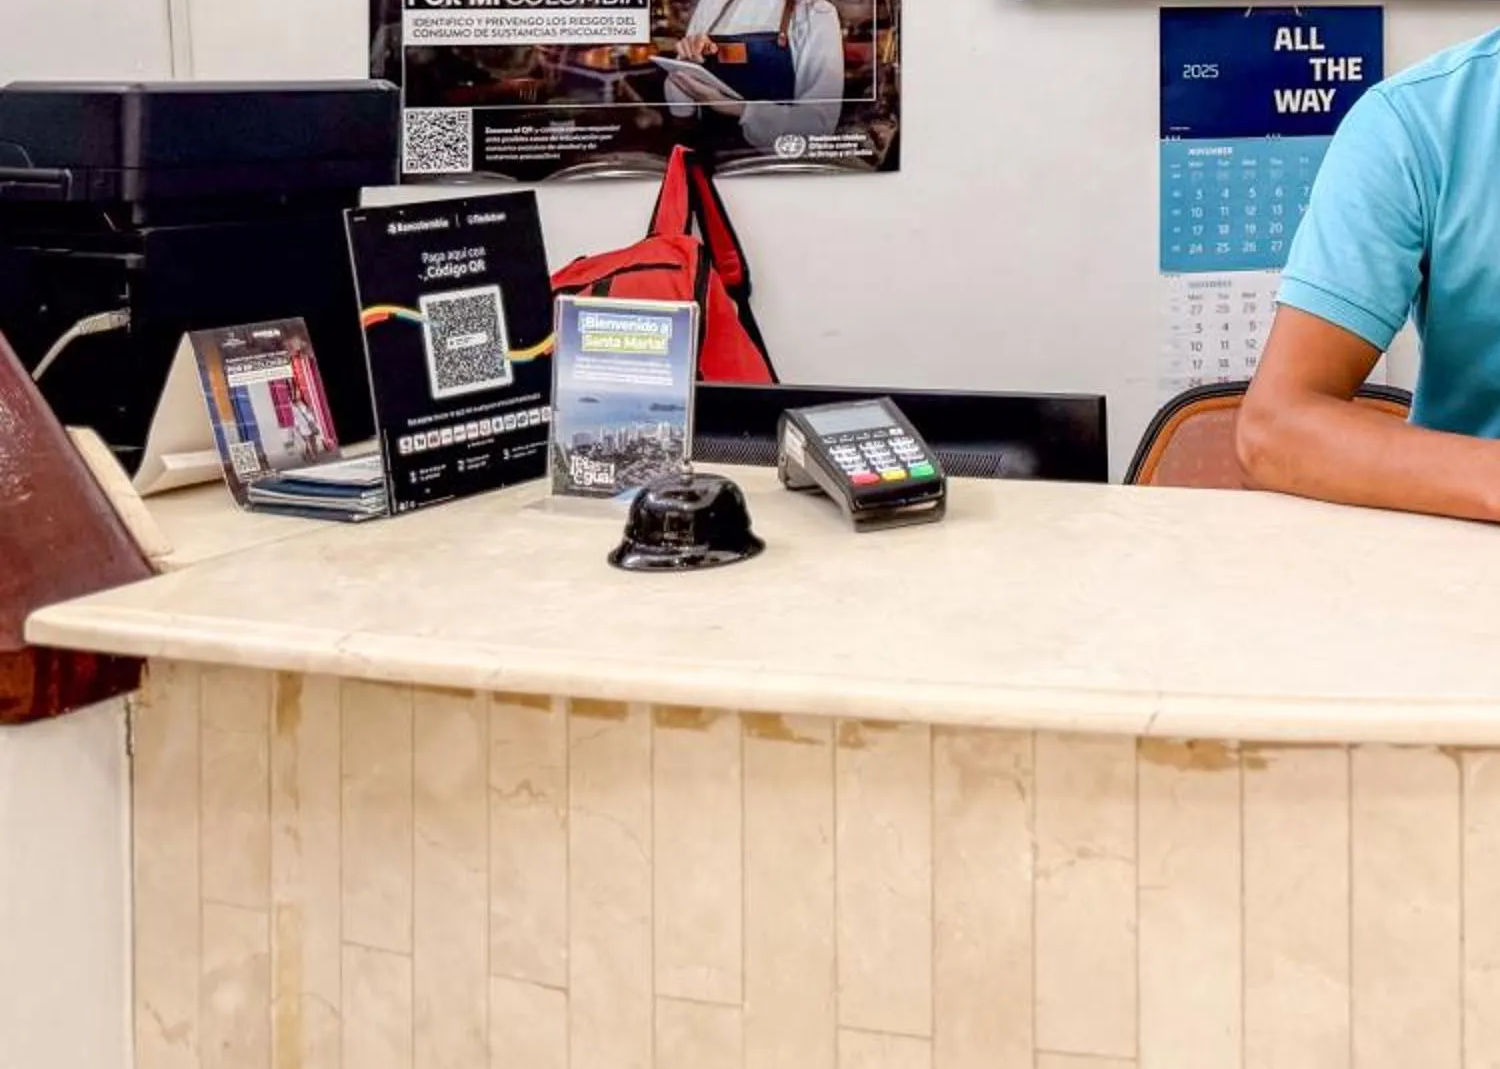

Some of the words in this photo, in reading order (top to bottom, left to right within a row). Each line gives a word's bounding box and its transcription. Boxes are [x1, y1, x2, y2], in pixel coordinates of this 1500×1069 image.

[413, 17, 474, 27] IDENTIFICO
[477, 18, 484, 27] Y
[486, 17, 545, 27] PREVENGO
[546, 16, 567, 26] LOS
[569, 16, 614, 26] RIESGOS
[616, 16, 636, 26] DEL
[413, 29, 471, 39] CONSUMO
[473, 29, 489, 38] DE
[491, 28, 558, 38] SUSTANCIAS
[559, 27, 637, 37] PSICOACTIVAS
[1274, 26, 1325, 51] ALL
[1183, 64, 1219, 78] 2025
[1309, 57, 1363, 81] THE
[1274, 88, 1336, 113] WAY
[1222, 188, 1229, 199] 4
[1249, 188, 1256, 198] 5
[1275, 187, 1283, 197] 6
[1191, 207, 1203, 218] 10
[468, 259, 486, 272] QR
